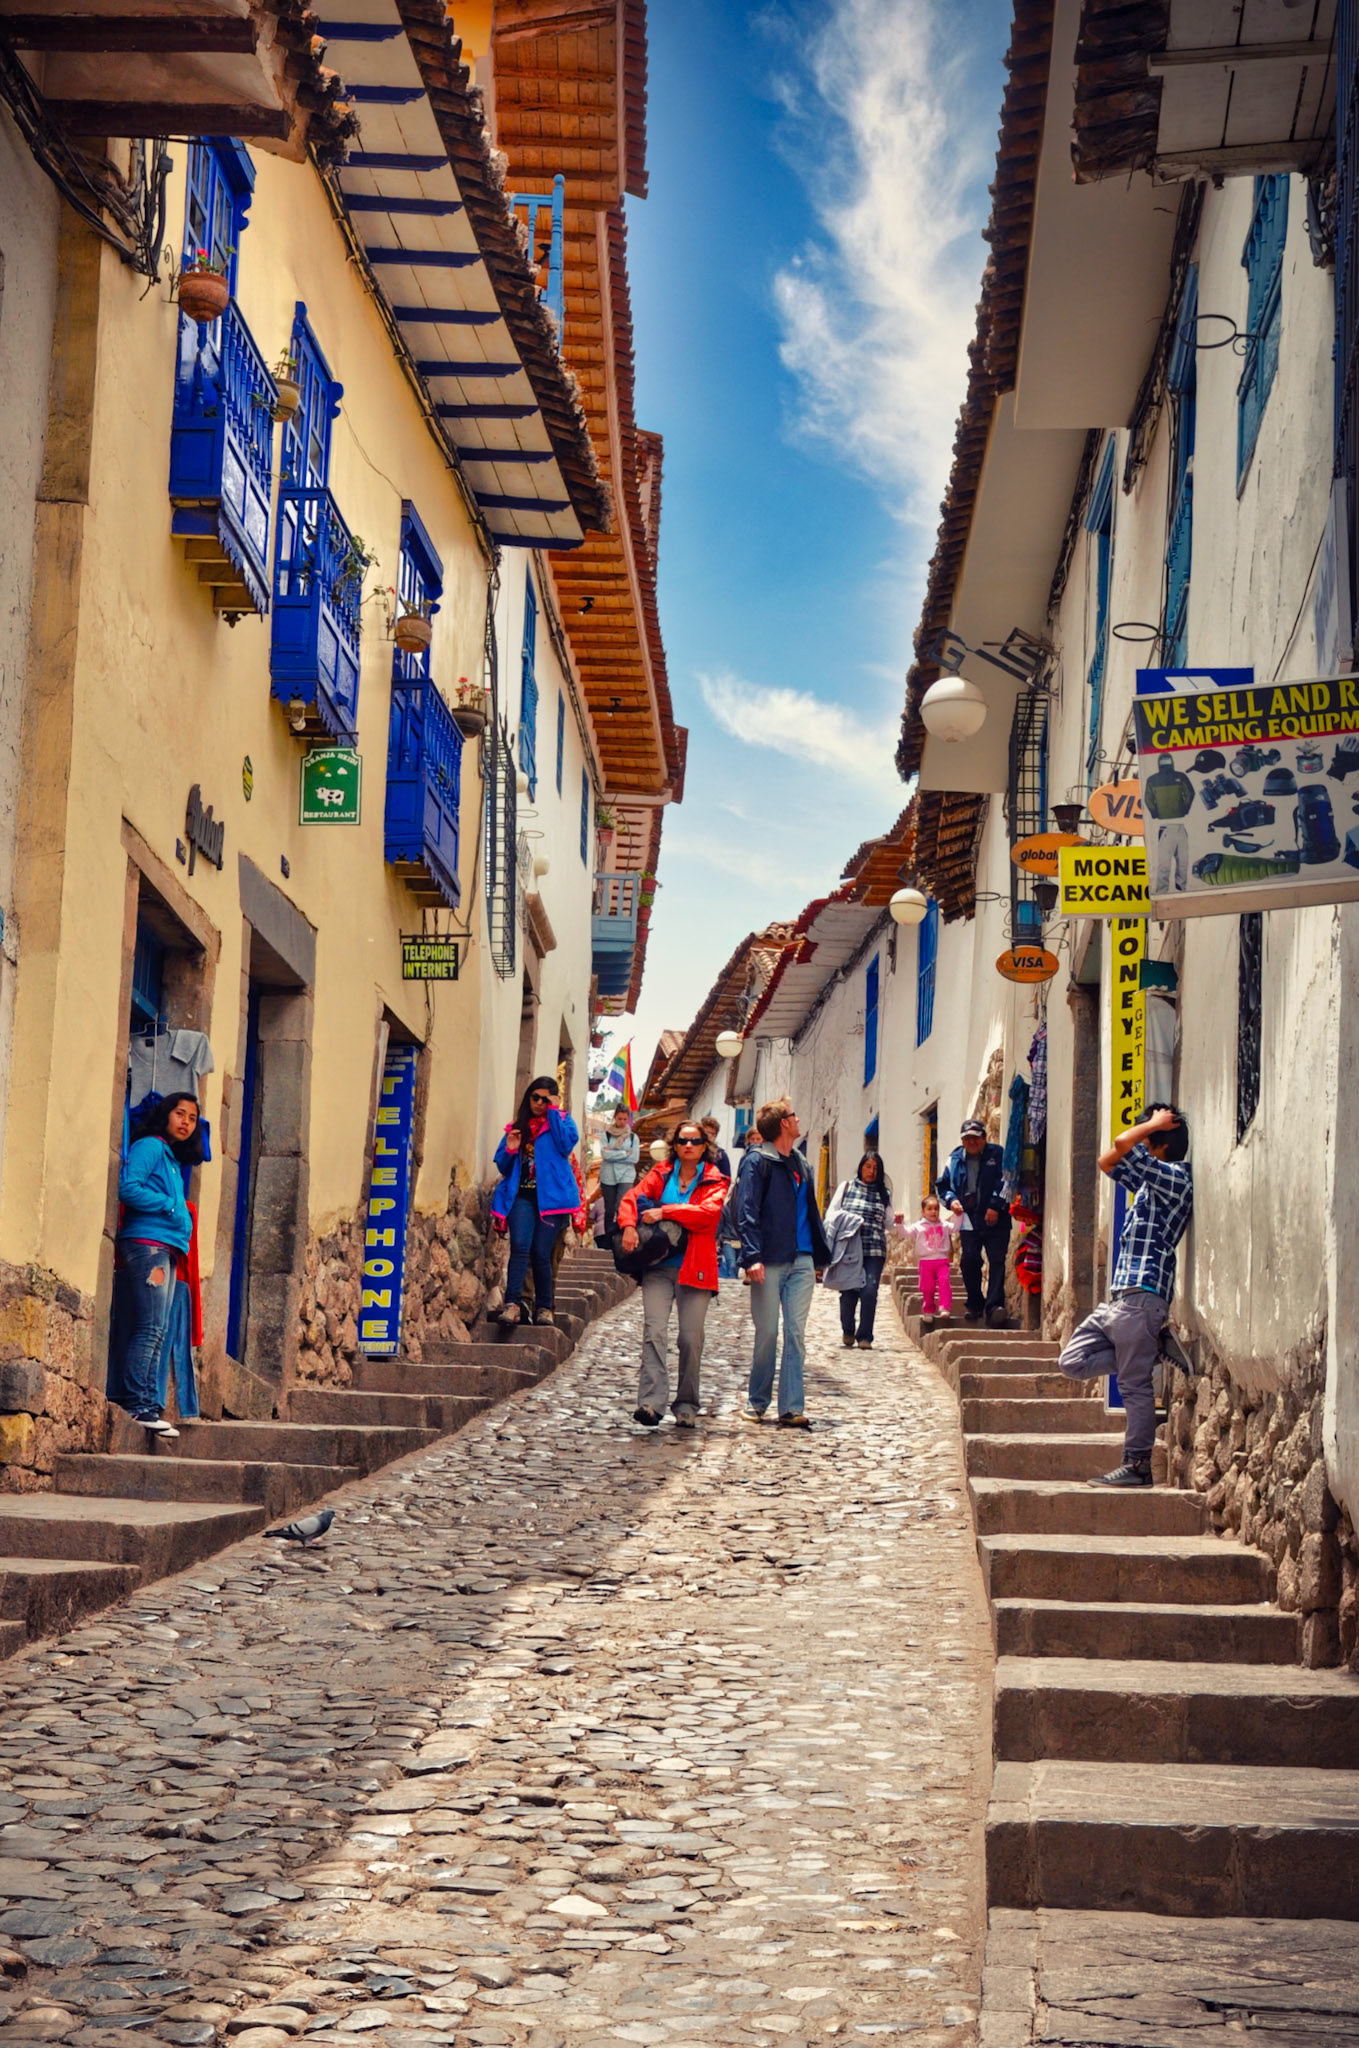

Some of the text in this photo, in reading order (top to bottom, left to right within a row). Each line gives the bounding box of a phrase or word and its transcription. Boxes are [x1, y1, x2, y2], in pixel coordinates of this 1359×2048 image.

[1141, 697, 1190, 729] WE
[1196, 690, 1264, 723] SELL
[1269, 682, 1331, 716] AND
[1151, 709, 1359, 750] CAMPING EQUIPM
[305, 751, 359, 767] GRANJA HEIDI
[303, 810, 357, 819] RESTAURANT
[403, 944, 456, 961] TELEPHONE
[403, 961, 456, 978] INTERNET
[1011, 956, 1044, 968] VISA
[361, 1076, 404, 1339] TELEPHONE
